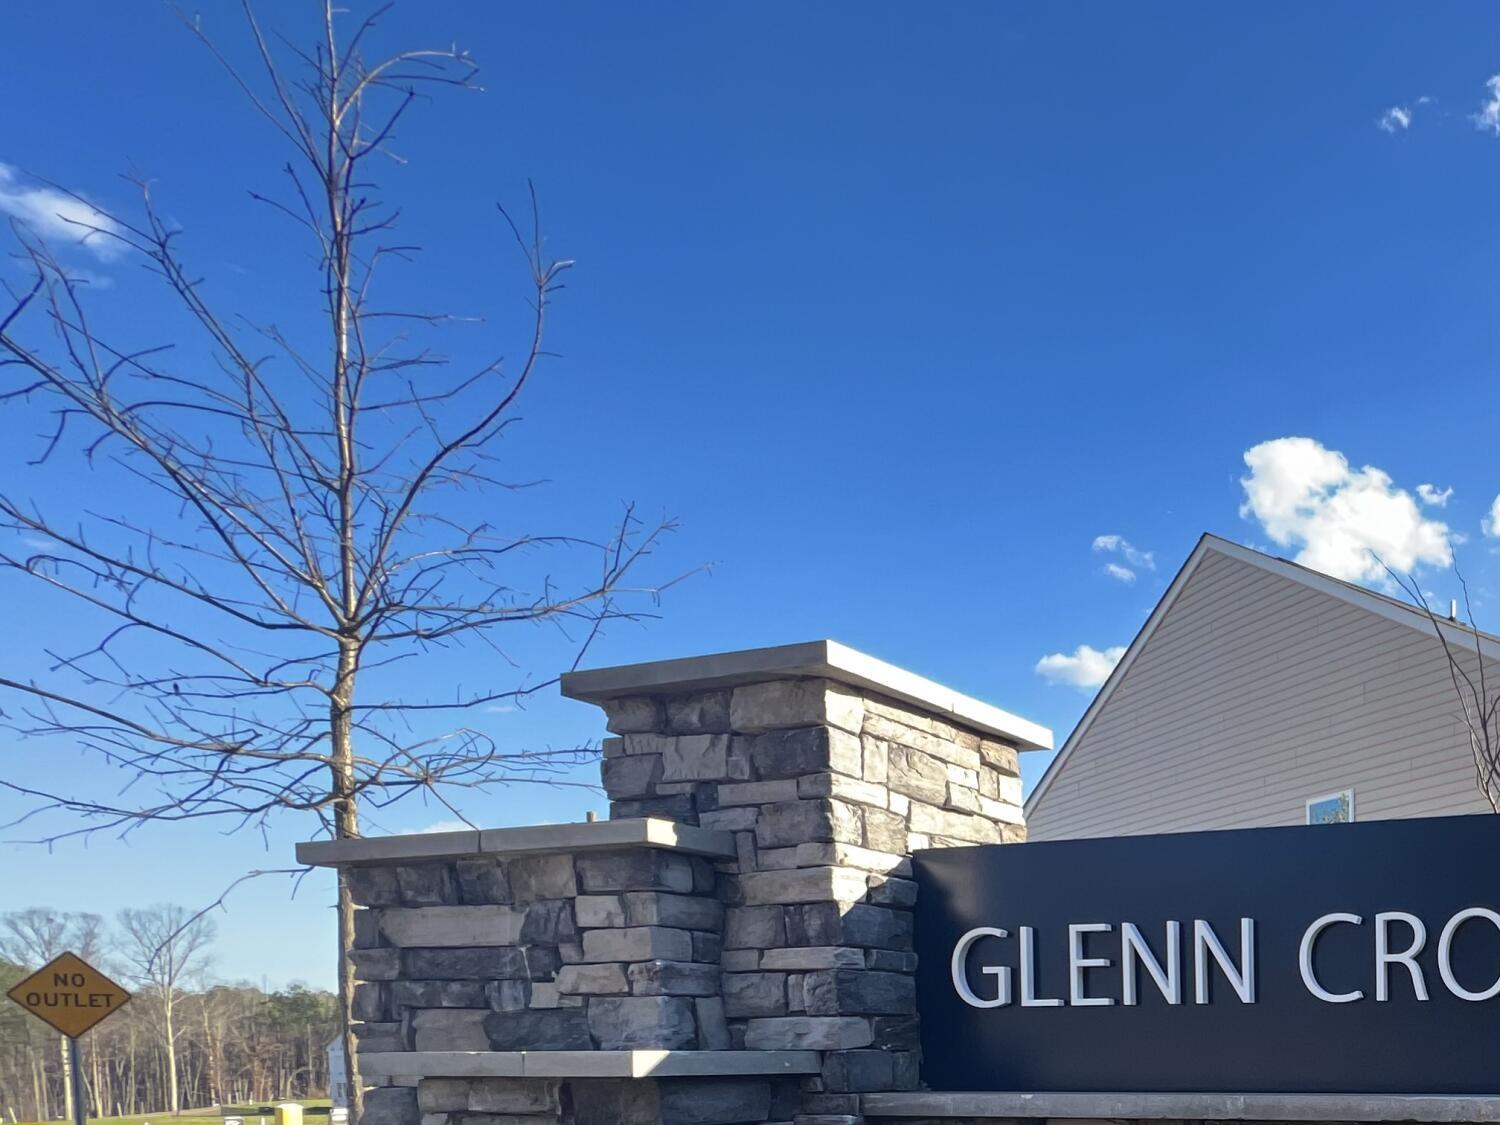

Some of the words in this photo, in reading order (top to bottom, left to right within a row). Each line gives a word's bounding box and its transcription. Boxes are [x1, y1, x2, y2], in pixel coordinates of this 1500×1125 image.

[951, 917, 1256, 1008] GLENN
[53, 973, 86, 988] NO
[26, 992, 113, 1008] OUTLET
